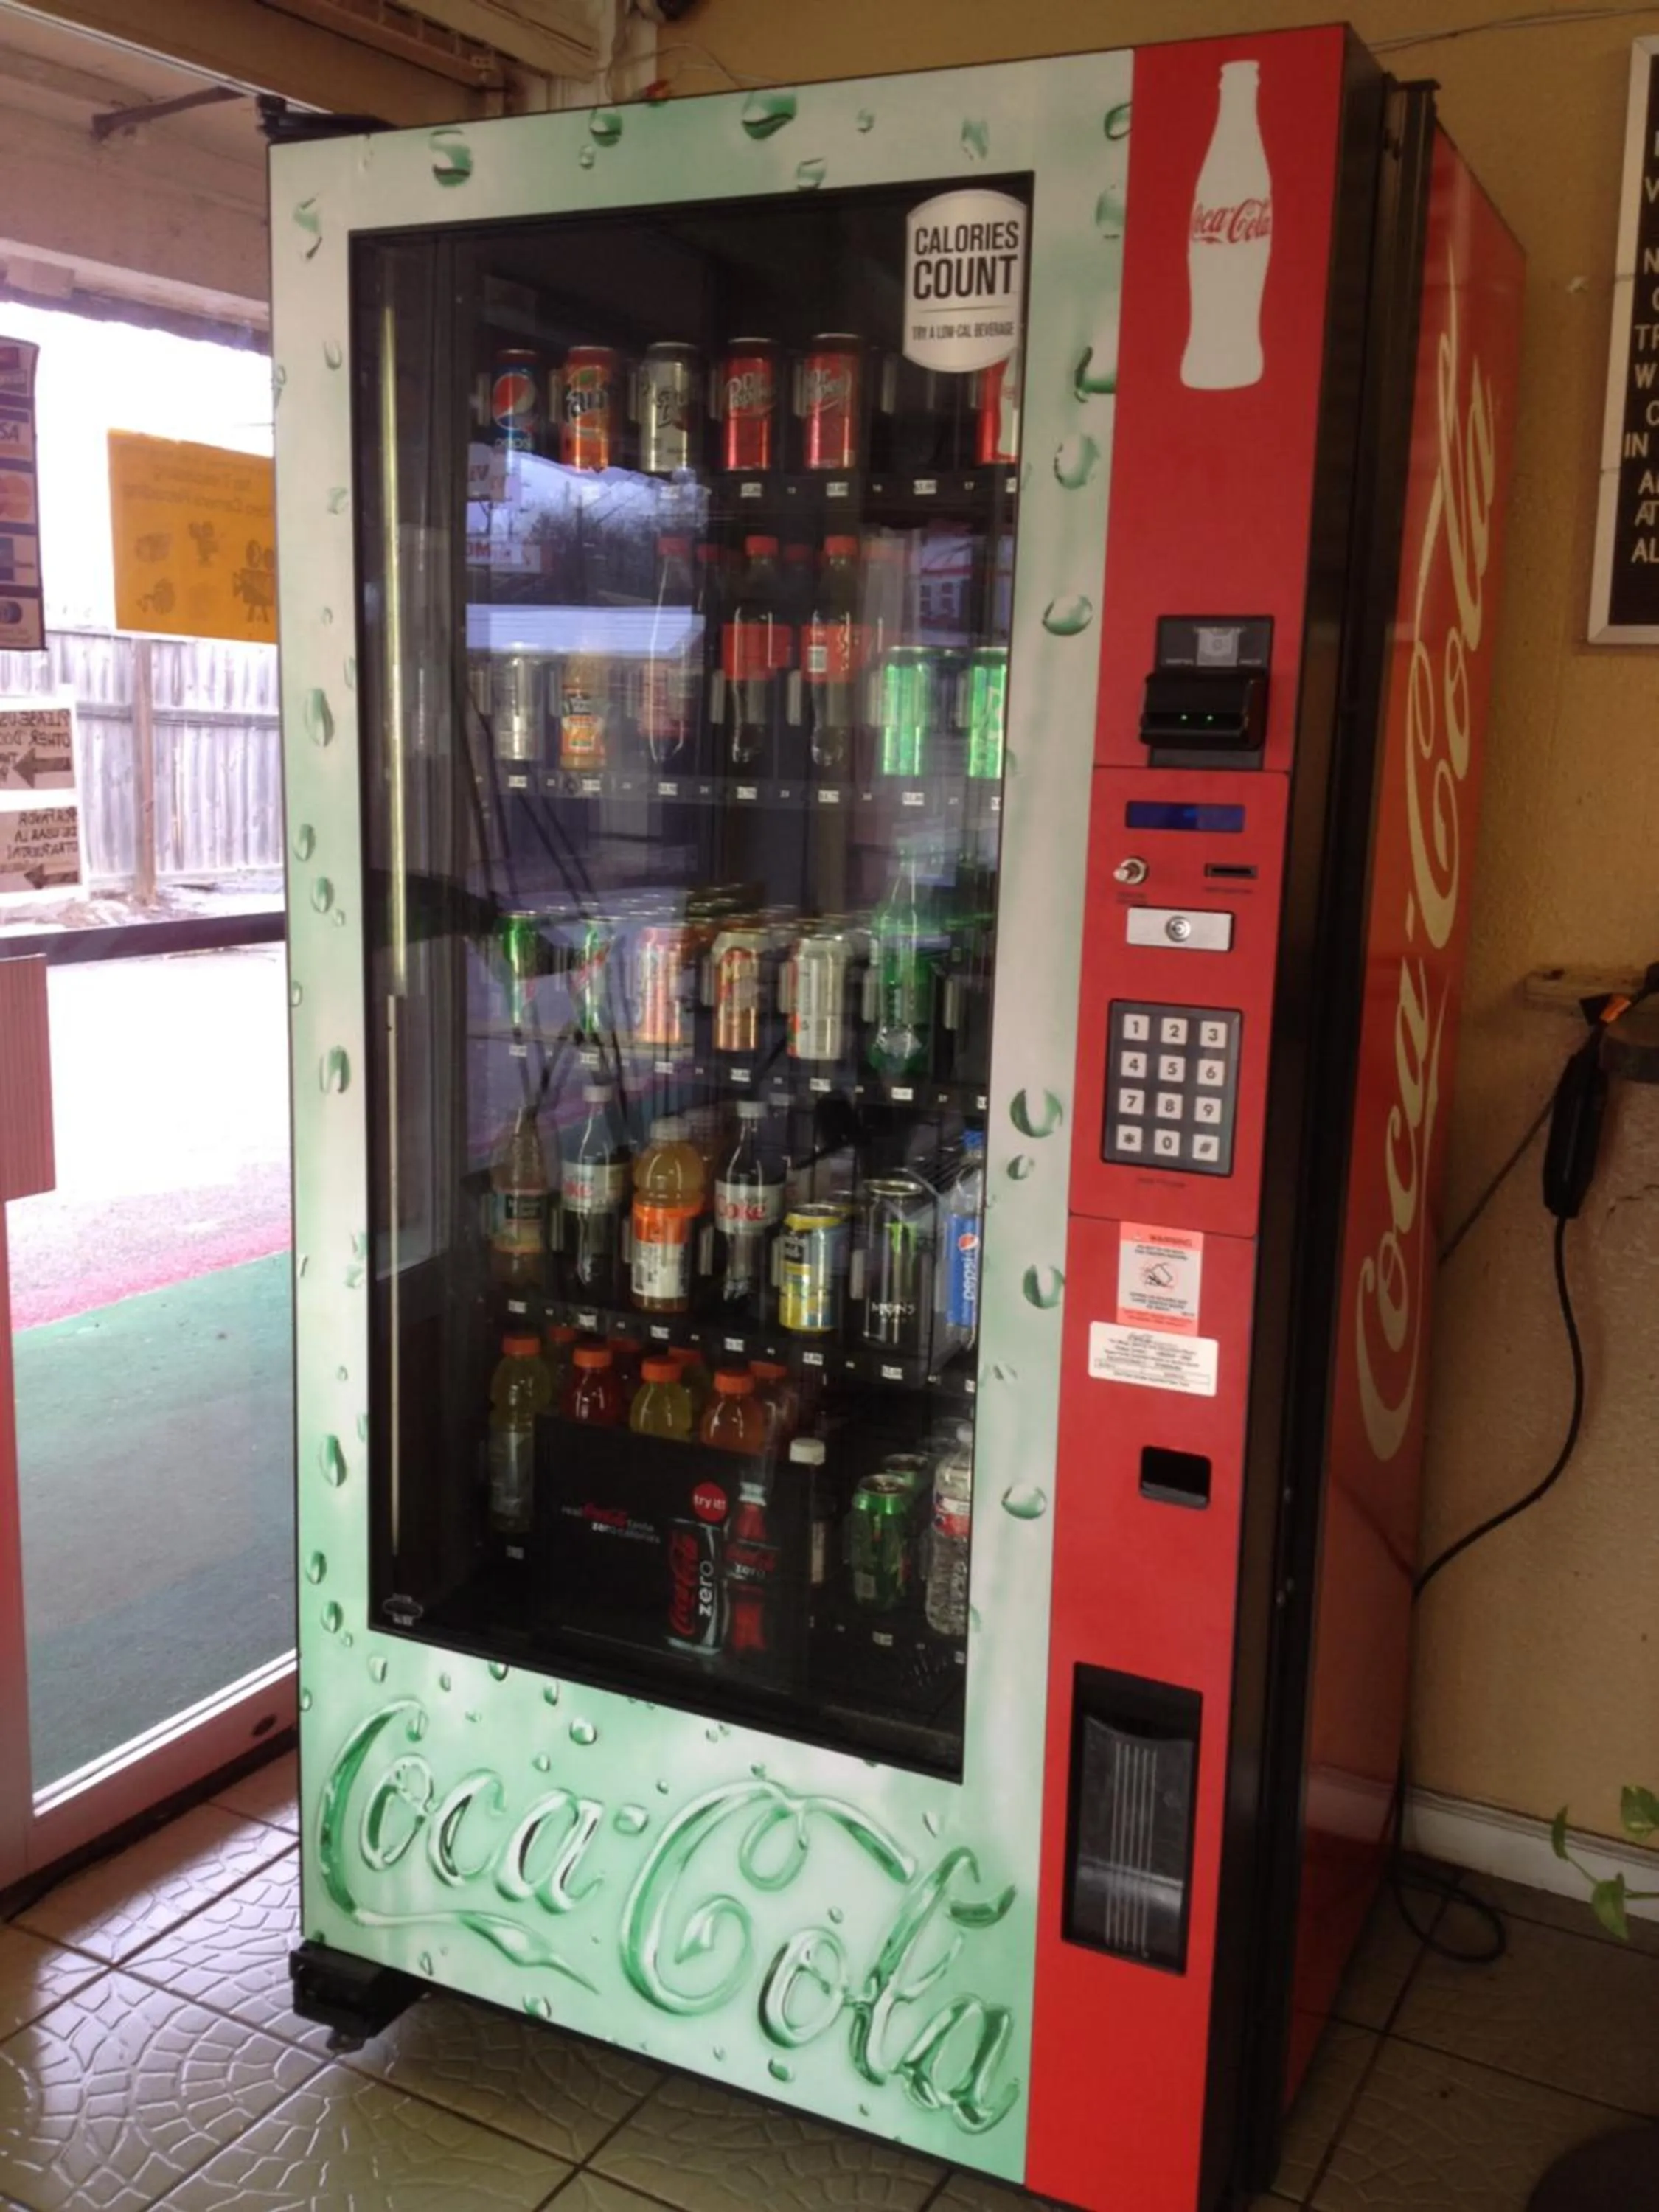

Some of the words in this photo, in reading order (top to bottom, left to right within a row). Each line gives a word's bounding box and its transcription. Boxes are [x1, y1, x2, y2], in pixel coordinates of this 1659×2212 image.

[914, 220, 1019, 255] CALORIES
[913, 254, 1018, 300] COUNT
[911, 325, 927, 340] TRY
[929, 325, 934, 339] A
[936, 324, 972, 339] LOW-CAL
[974, 321, 1015, 338] BEVERAGE
[1624, 432, 1649, 458] IN
[1133, 1020, 1141, 1034] 1
[1169, 1024, 1180, 1039] 2
[1208, 1029, 1219, 1042] 3
[1128, 1058, 1139, 1072] 4
[1167, 1062, 1178, 1076] 5
[1206, 1066, 1217, 1080] 6
[1127, 1095, 1138, 1108] 7
[1164, 1099, 1176, 1113] 8
[1203, 1103, 1214, 1117] 9
[1162, 1136, 1172, 1150] 0
[693, 1493, 712, 1509] try
[698, 1560, 714, 1617] zero
